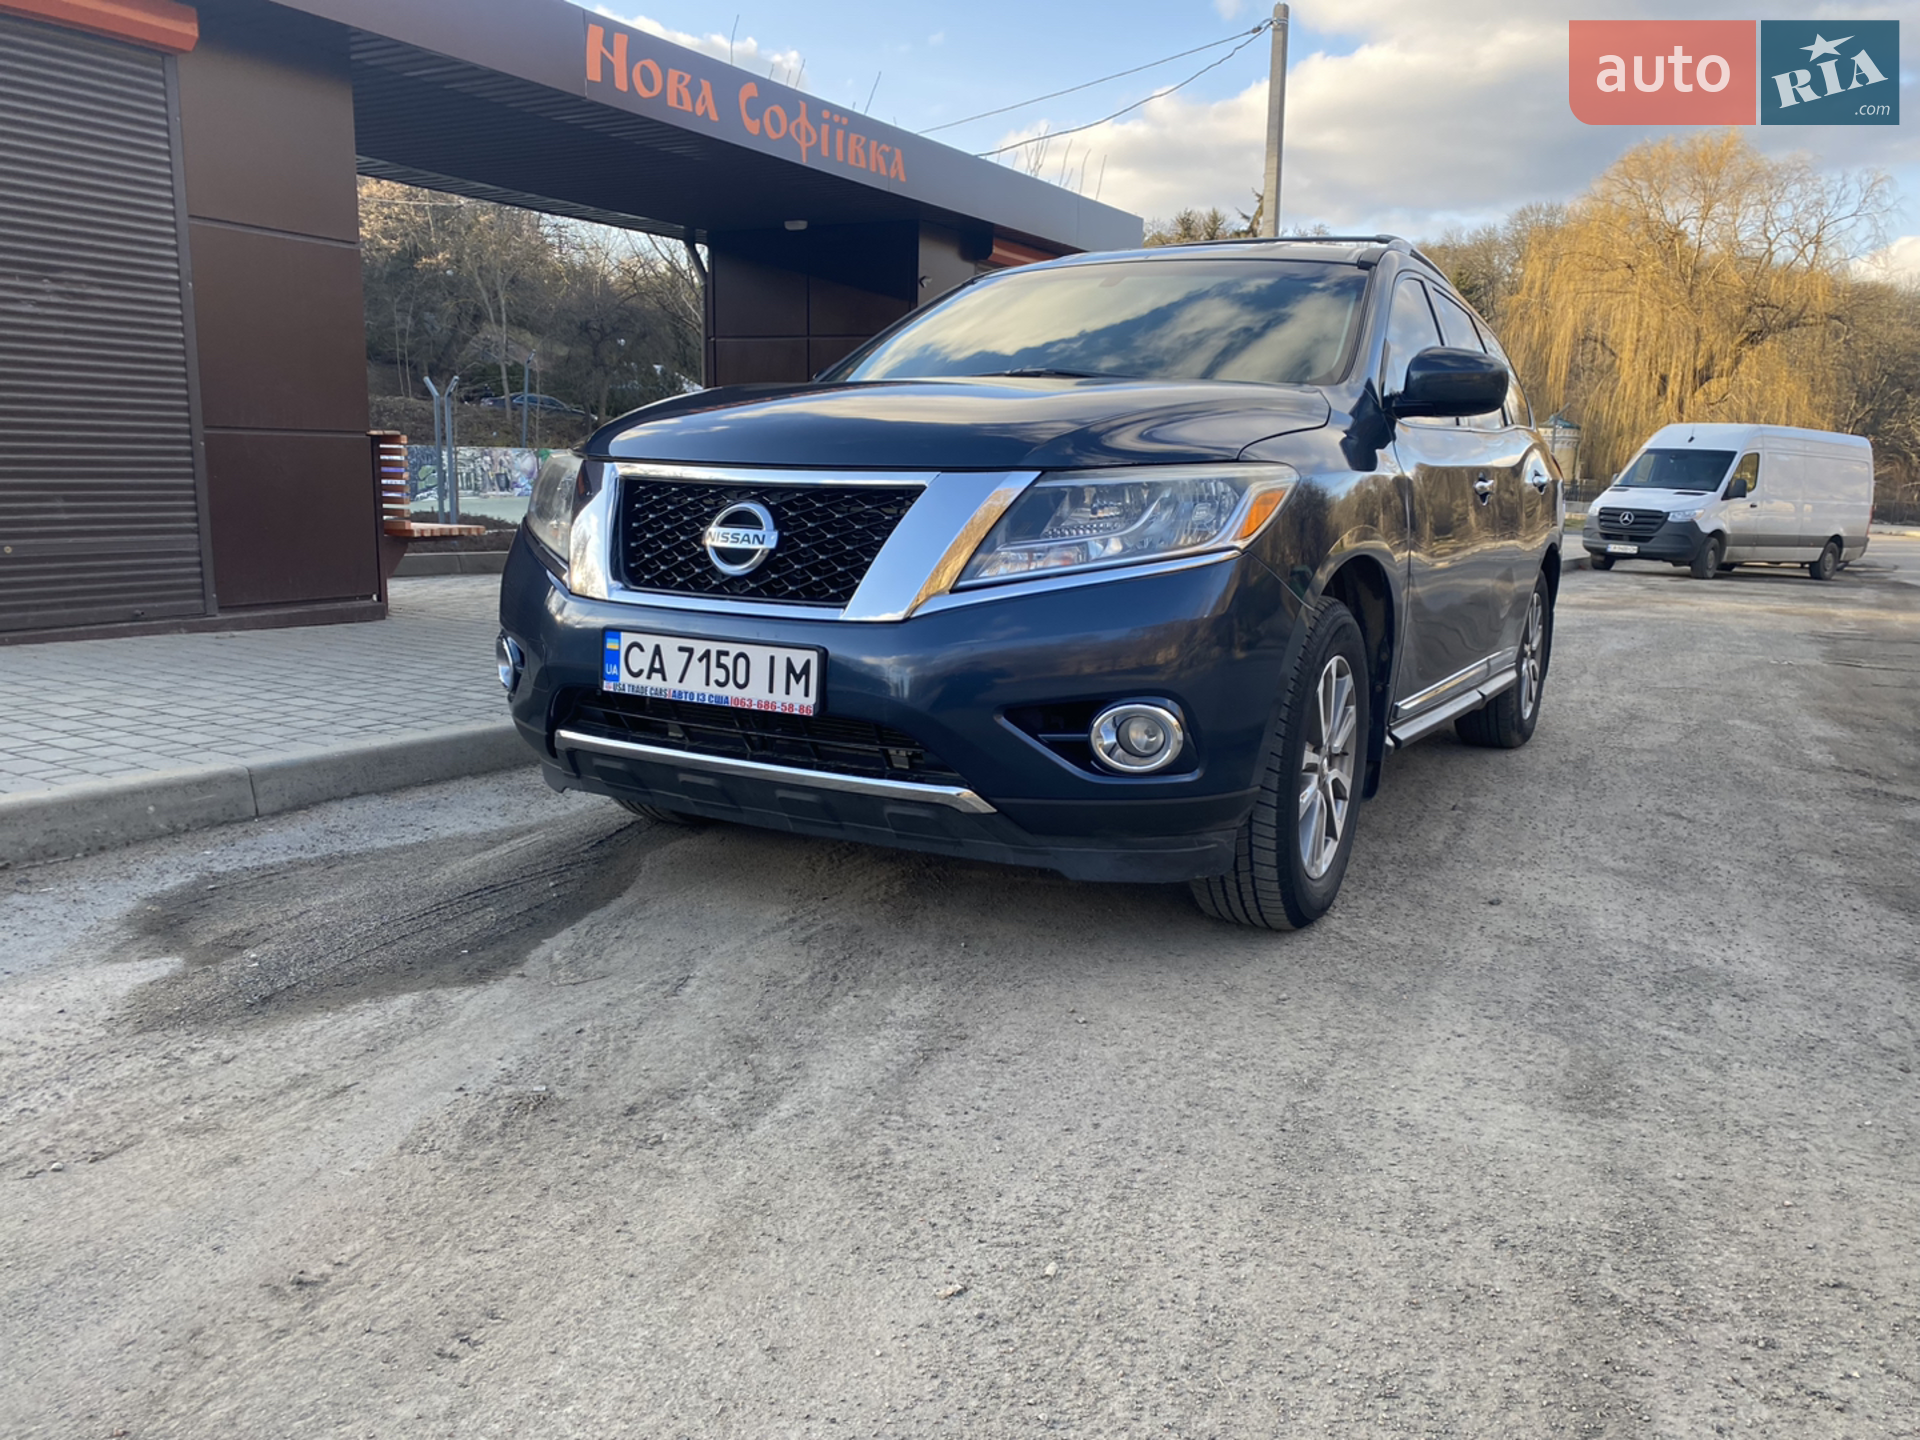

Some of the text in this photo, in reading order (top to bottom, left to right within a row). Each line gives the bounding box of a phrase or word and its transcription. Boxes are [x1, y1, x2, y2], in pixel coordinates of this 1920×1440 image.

[586, 24, 907, 183] Нова Софіївка
[708, 531, 766, 546] NISSAN
[605, 663, 619, 676] UA
[624, 641, 812, 698] CA 7150 IM
[613, 682, 626, 693] USA
[627, 684, 649, 696] TRADE
